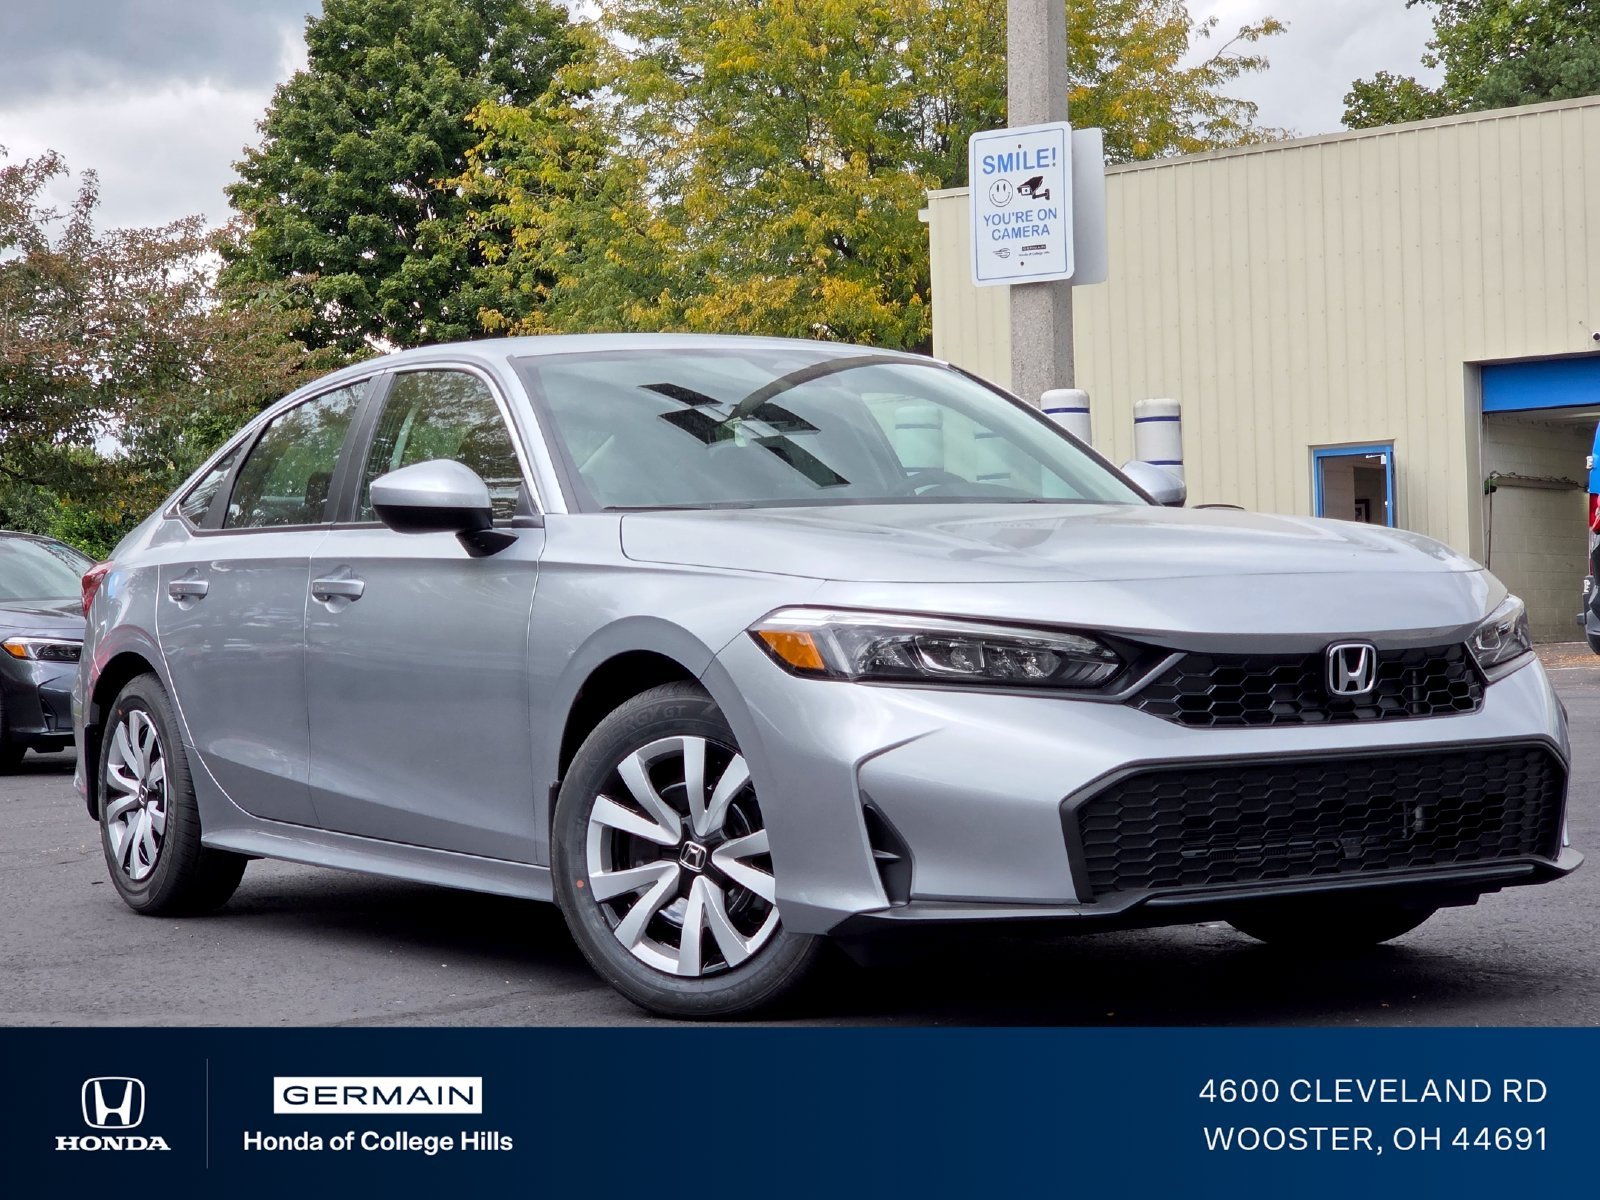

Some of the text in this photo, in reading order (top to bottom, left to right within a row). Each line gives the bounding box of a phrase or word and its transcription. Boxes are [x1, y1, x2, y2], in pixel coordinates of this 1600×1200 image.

[982, 147, 1057, 175] SMILE!
[984, 207, 1057, 227] YOU'RE ON
[992, 224, 1050, 241] CAMERA
